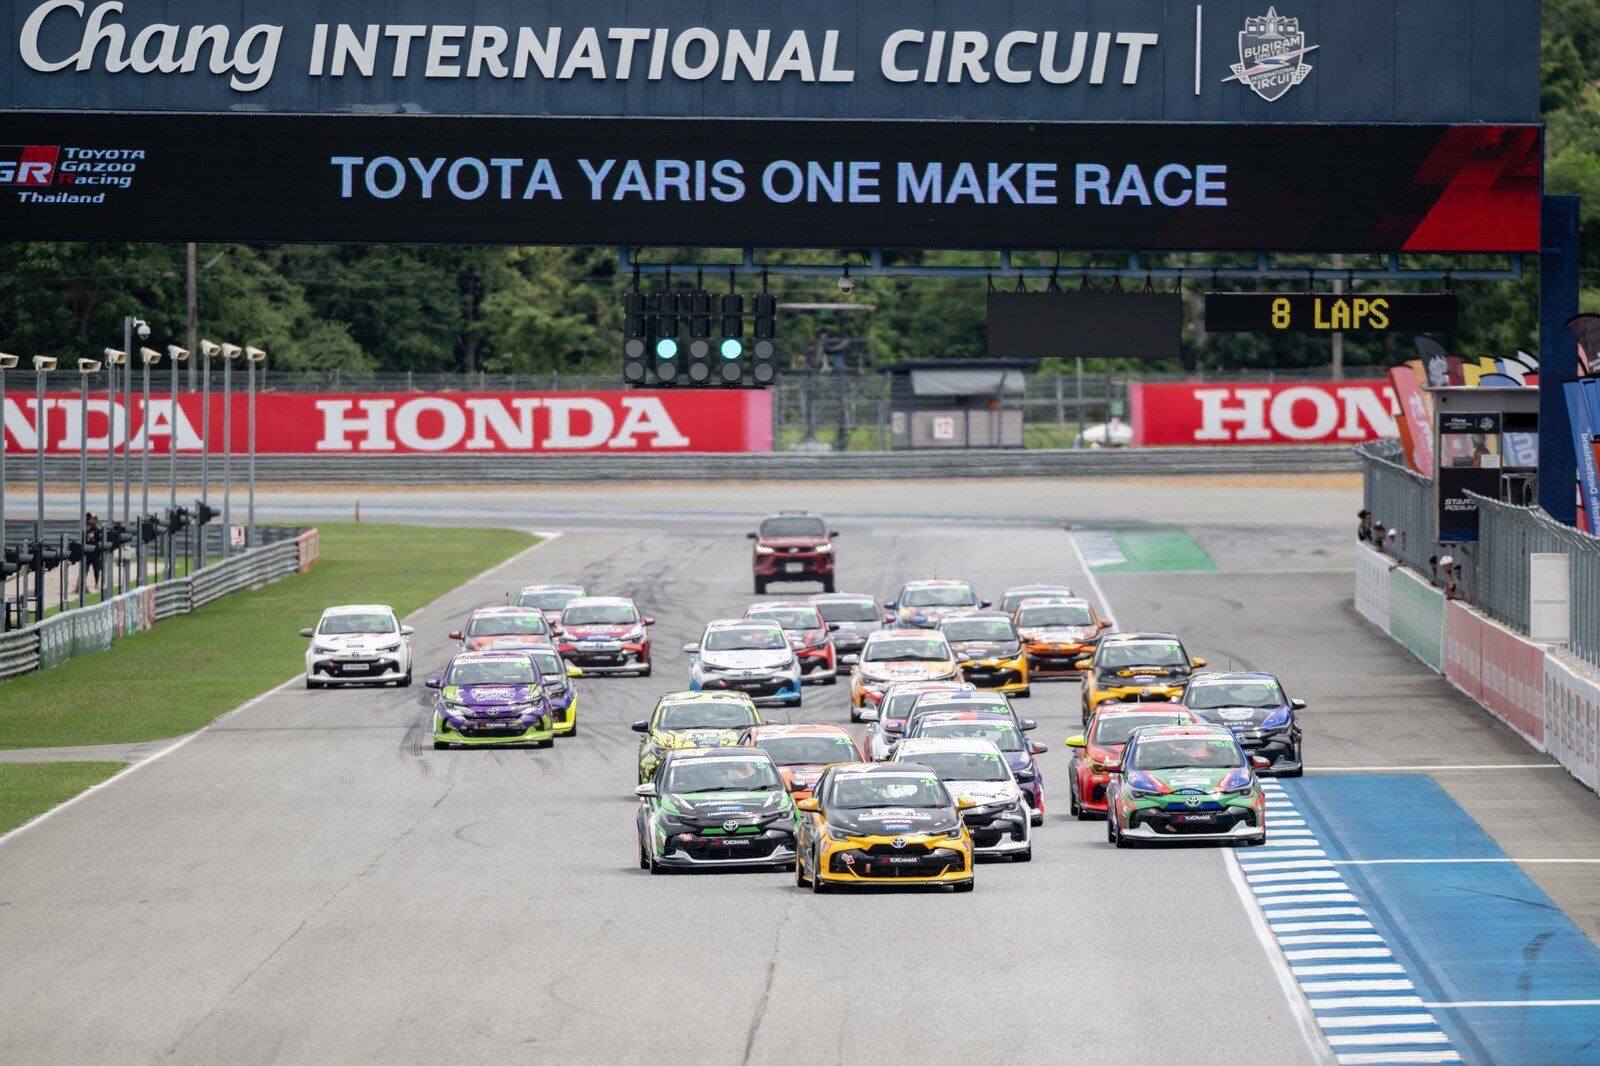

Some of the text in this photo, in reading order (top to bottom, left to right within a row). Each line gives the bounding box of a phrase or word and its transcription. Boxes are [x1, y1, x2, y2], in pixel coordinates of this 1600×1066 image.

[20, 0, 1158, 91] Chang INTERNATIONAL CIRCUIT
[1244, 36, 1300, 58] BURIRAM
[1251, 71, 1296, 90] CIRCUIT
[64, 147, 145, 159] TOYOTA
[60, 160, 136, 172] GAZOO
[58, 174, 132, 188] Racing
[332, 157, 1226, 205] TOYOTA YARIS ONE MAKE RACE
[18, 191, 106, 203] Thailand
[1271, 297, 1390, 330] 8 LAPS
[315, 396, 690, 451] HONDA
